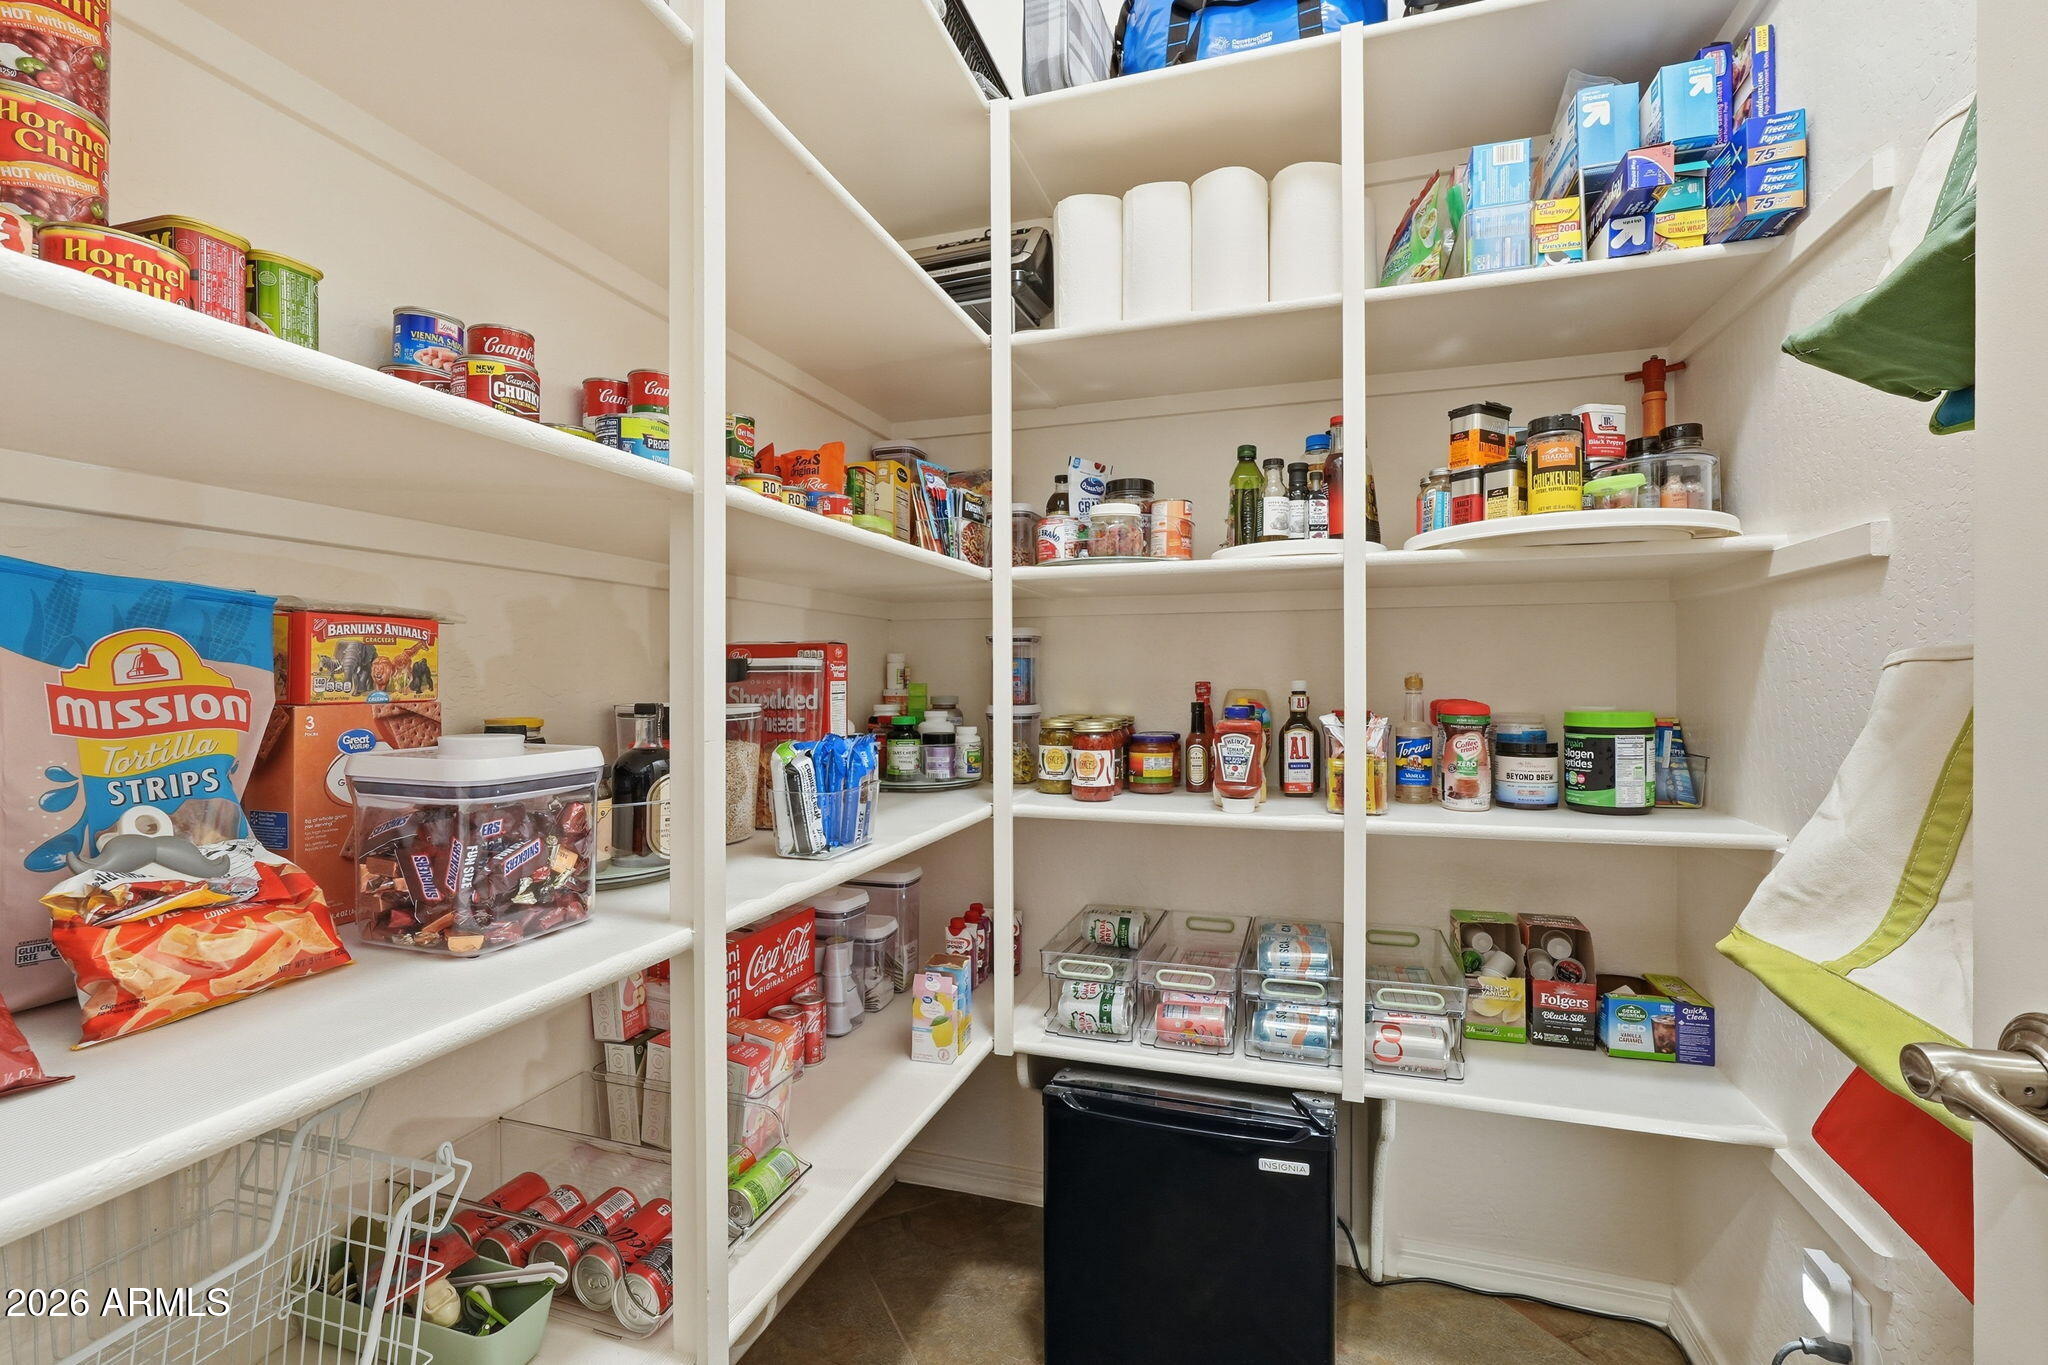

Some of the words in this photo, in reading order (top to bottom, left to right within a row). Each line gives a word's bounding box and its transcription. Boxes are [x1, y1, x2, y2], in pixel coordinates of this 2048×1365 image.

[1, 7, 32, 20] HOT
[36, 15, 66, 31] with
[66, 21, 100, 46] Beans
[0, 97, 108, 163] Hormel
[1764, 121, 1798, 134] Freezer
[1760, 133, 1786, 144] Paper
[14, 128, 99, 178] Chili
[1754, 147, 1777, 162] 75
[2, 166, 31, 179] HOT
[34, 171, 66, 185] with
[66, 176, 98, 195] Beans
[1763, 172, 1797, 184] Freezer
[1759, 183, 1786, 193] Paper
[1753, 196, 1776, 211] 75
[1559, 223, 1577, 232] 200
[1687, 224, 1706, 232] WRAP
[64, 236, 183, 291] Hormel
[410, 330, 445, 344] VIENNA
[1606, 439, 1624, 447] Pepper
[805, 477, 829, 491] Rice
[1533, 471, 1566, 489] CHICKEN
[1041, 528, 1061, 544] BRAND
[327, 623, 382, 636] BARNUM'S
[384, 624, 429, 640] ANIMALS
[56, 693, 248, 730] MISSION
[305, 715, 316, 730] 3
[342, 735, 370, 745] Great
[1226, 738, 1246, 746] HEINZ
[1454, 740, 1479, 750] Coffee
[100, 733, 220, 776] Tortilla
[1396, 739, 1432, 760] Torani
[1460, 745, 1479, 754] mate
[1506, 772, 1535, 781] BEYOND
[1536, 773, 1554, 781] BREW
[107, 767, 221, 806] STRIPS
[463, 845, 478, 867] FUN
[504, 842, 540, 874] SNICKERS
[446, 839, 463, 890] SNICKERS
[413, 854, 439, 899] SNICKERS
[461, 866, 476, 890] SIZE
[18, 943, 53, 956] GLUTEN
[18, 953, 39, 963] FREE
[753, 976, 785, 998] ORIGINAL
[786, 964, 805, 979] TASTE
[1540, 992, 1589, 1009] Folgers
[1541, 1010, 1569, 1021] Black
[1569, 1013, 1588, 1023] Silk
[1681, 1007, 1704, 1015] Quick
[1617, 1023, 1647, 1032] ICED
[1532, 1031, 1544, 1040] 24
[1261, 1161, 1307, 1174] INSIGNIA
